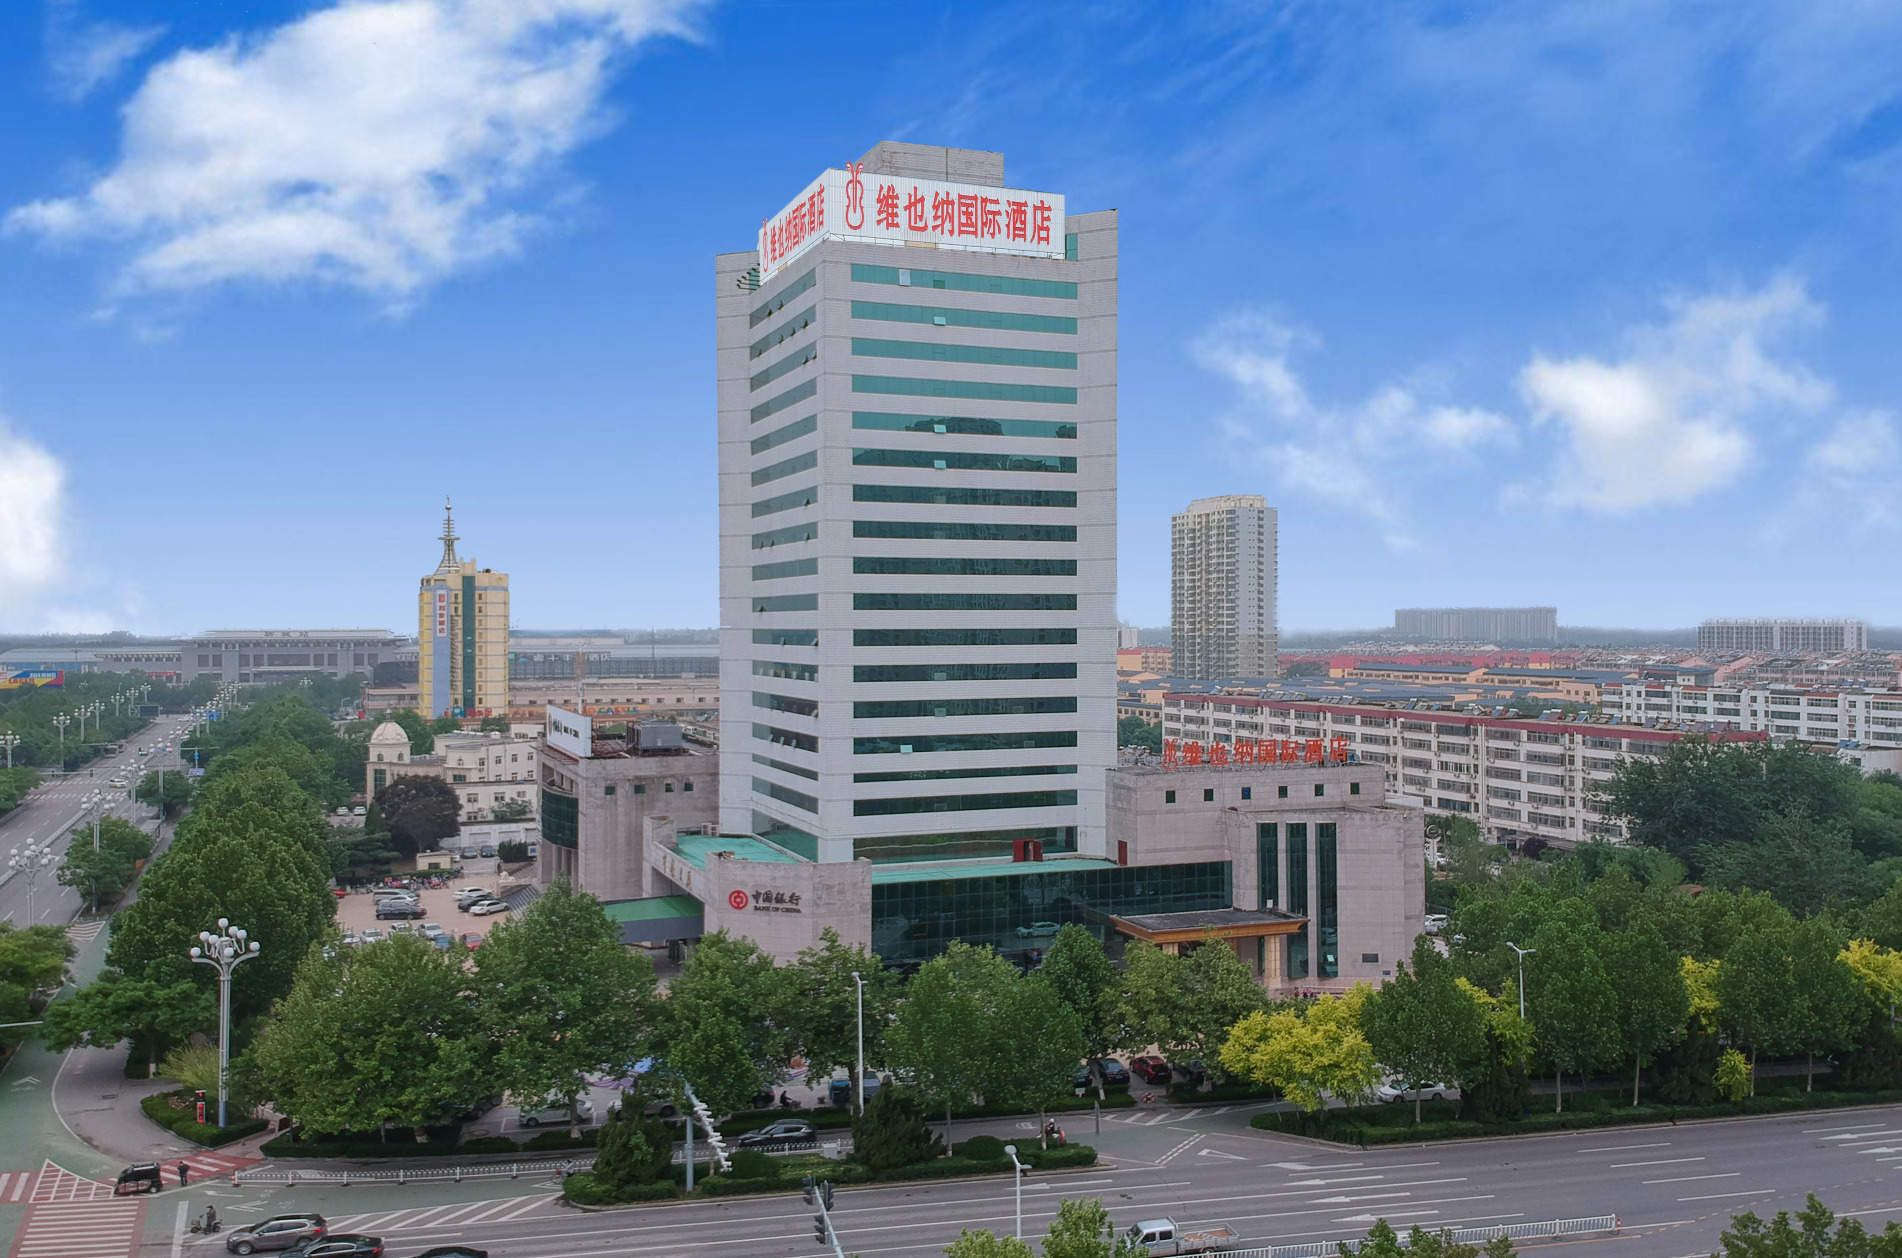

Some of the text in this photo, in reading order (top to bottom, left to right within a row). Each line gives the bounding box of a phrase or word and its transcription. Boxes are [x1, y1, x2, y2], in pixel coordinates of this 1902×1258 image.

[770, 183, 825, 264] 维也纳国际酒店
[876, 184, 1053, 246] 维也纳国际酒店
[1182, 735, 1349, 767] 维也纳国际酒店
